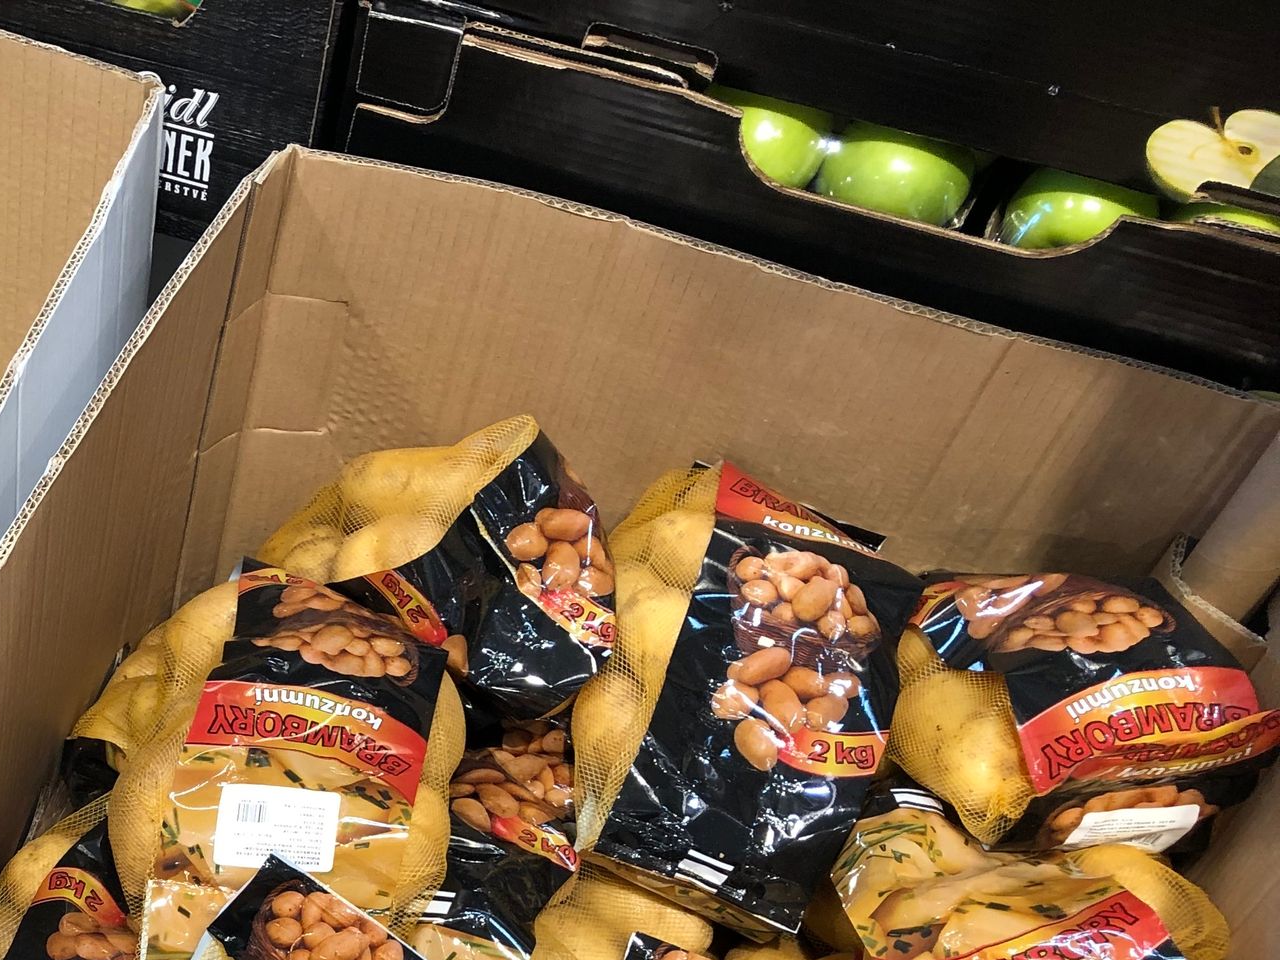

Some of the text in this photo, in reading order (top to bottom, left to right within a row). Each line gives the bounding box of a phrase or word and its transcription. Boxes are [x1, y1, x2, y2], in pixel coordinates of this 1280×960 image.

[163, 84, 219, 128] idl
[164, 129, 213, 182] NEK
[381, 573, 430, 624] 2 kg
[255, 687, 383, 731] konzumní
[1065, 673, 1196, 724] konzumní
[207, 703, 412, 777] BRAMBORY
[807, 739, 876, 770] 2 kg
[1041, 702, 1251, 780] BRAMBORY
[518, 829, 538, 848] 2
[48, 871, 104, 912] 2 kg
